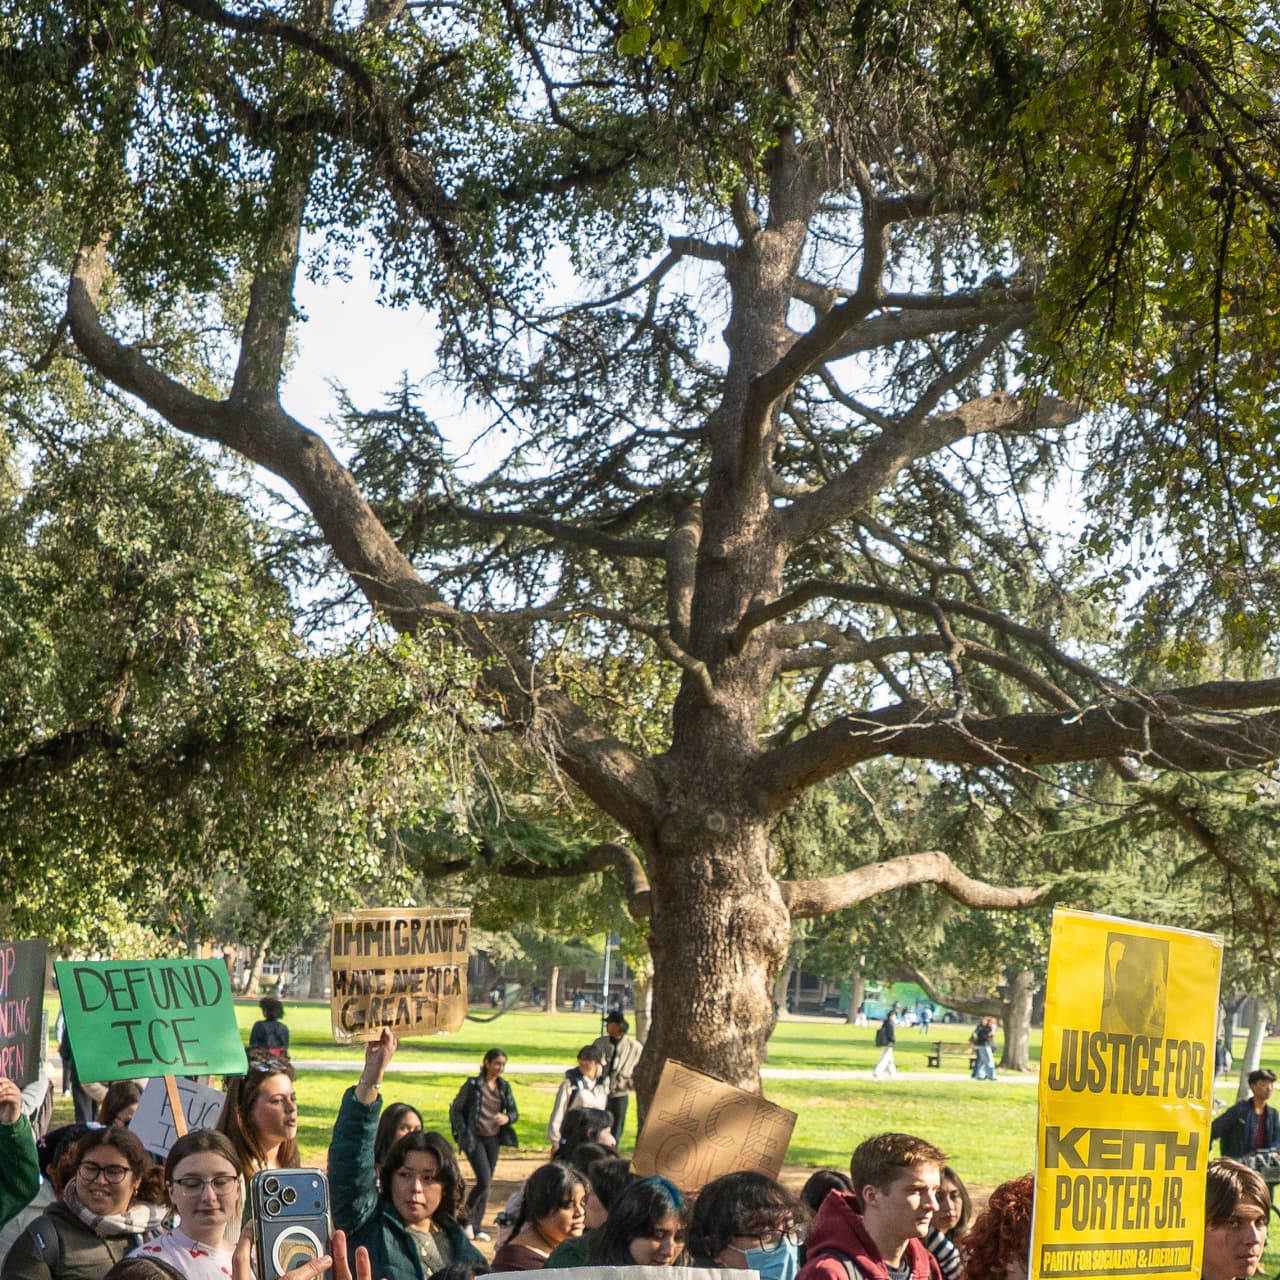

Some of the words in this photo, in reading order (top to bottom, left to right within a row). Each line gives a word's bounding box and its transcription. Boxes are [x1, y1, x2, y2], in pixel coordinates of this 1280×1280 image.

[333, 918, 468, 957] IMMIGRANTS
[72, 964, 224, 1013] DEFUND
[332, 968, 386, 997] MAKE
[390, 966, 462, 996] AMERICA
[110, 1016, 209, 1067] ICE
[1047, 1029, 1162, 1096] JUSTICE
[1162, 1038, 1206, 1100] FOR
[655, 1069, 792, 1166] ICE
[1044, 1126, 1200, 1172] KEITH
[1053, 1174, 1152, 1233] PORTER
[1153, 1176, 1186, 1230] JR.
[1043, 1251, 1073, 1272] PARTY
[1074, 1250, 1092, 1272] FOR
[1093, 1249, 1137, 1270] SOCIALISM
[1138, 1249, 1148, 1268] &
[1148, 1247, 1191, 1267] LIBERATION
